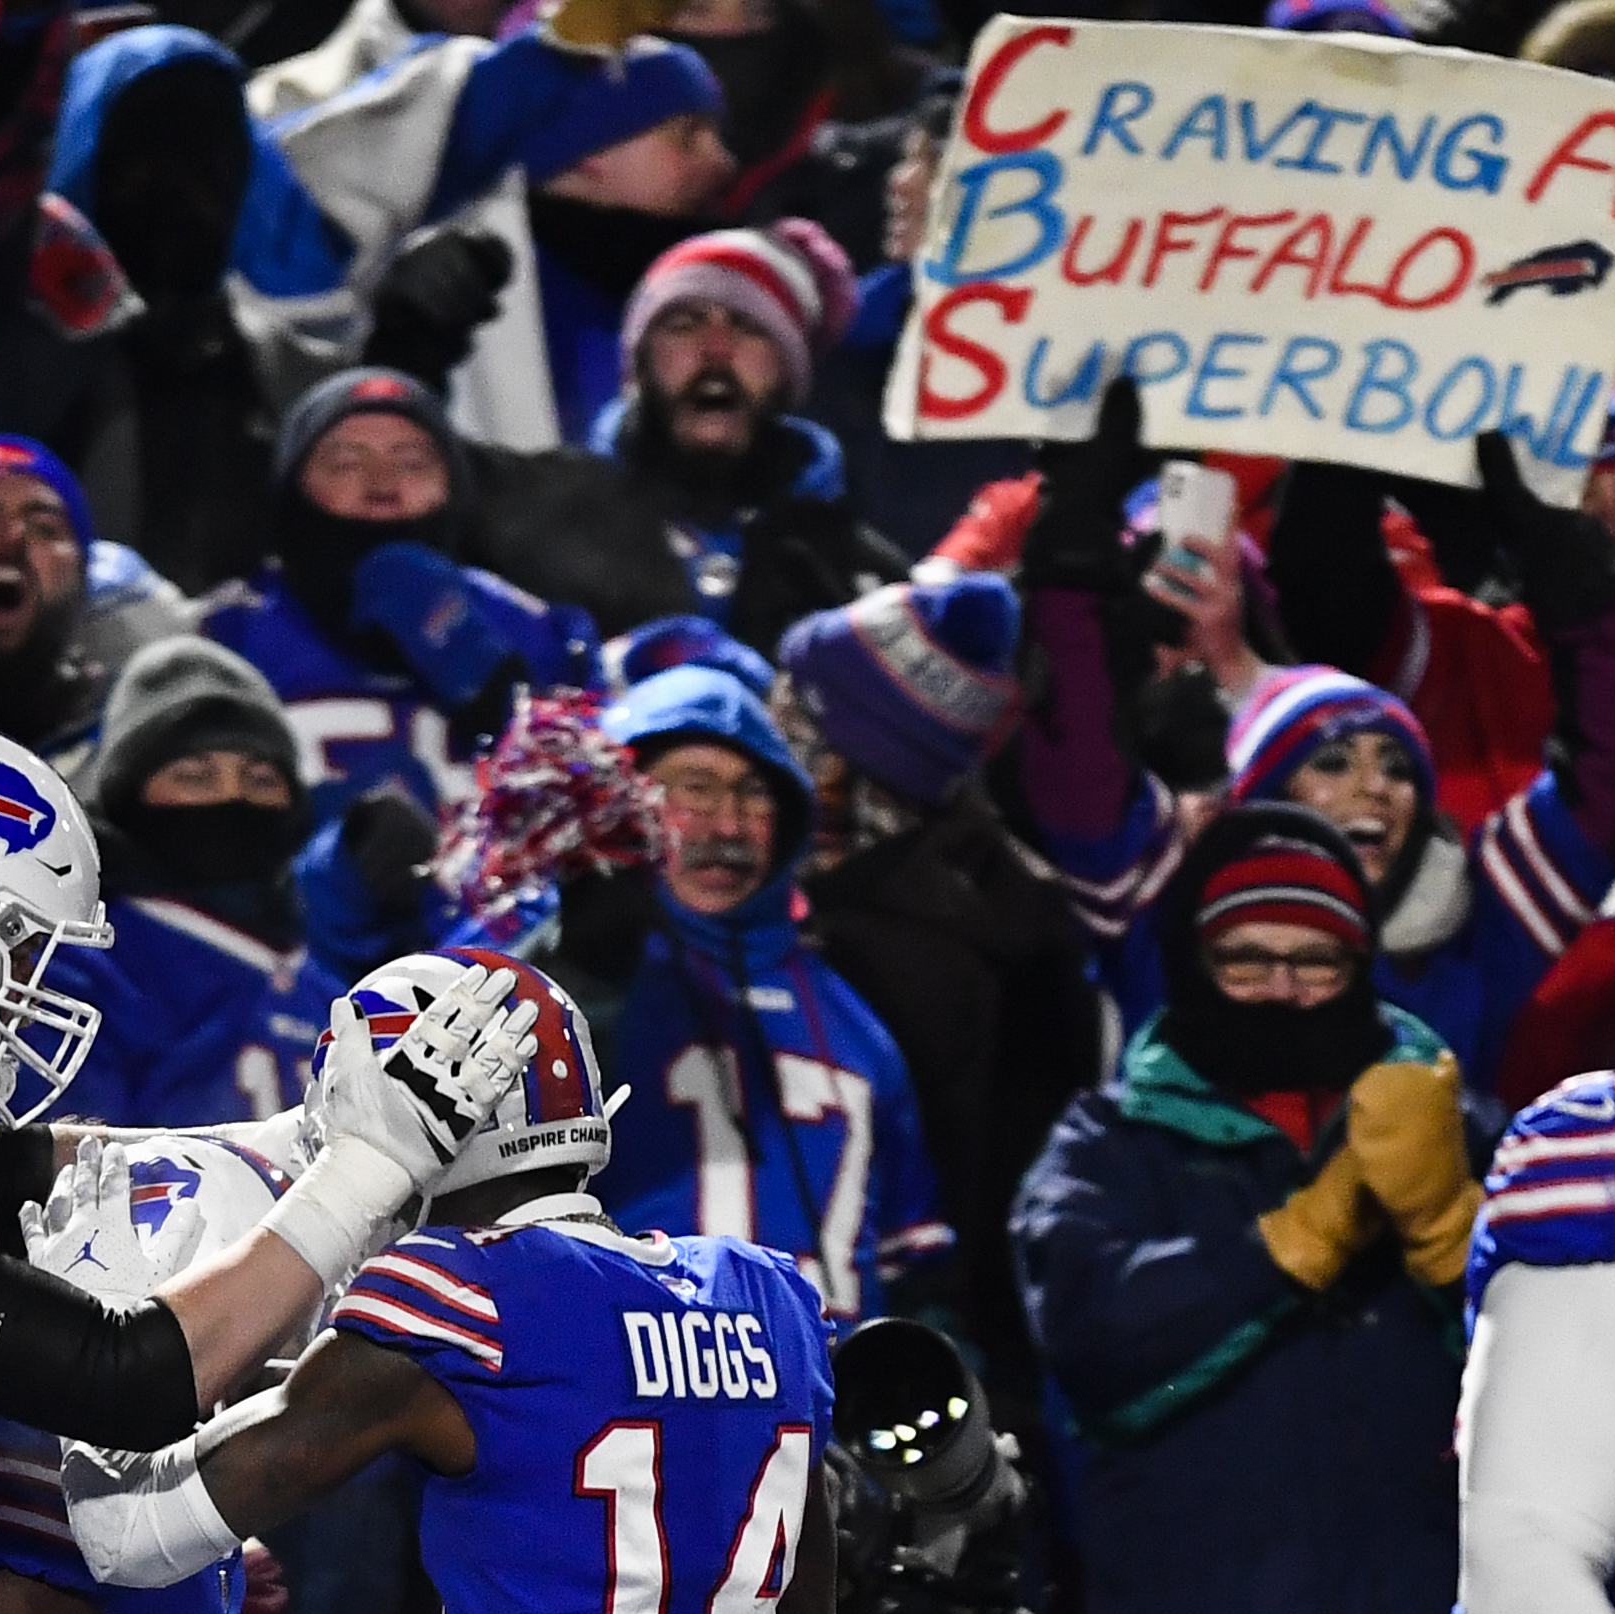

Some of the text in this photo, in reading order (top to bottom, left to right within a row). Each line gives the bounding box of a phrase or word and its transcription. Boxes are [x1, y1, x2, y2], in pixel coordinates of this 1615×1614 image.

[963, 26, 1509, 196] CRAVING
[923, 149, 1477, 312] BUFFALO
[916, 280, 1611, 469] SUPERBOWL
[498, 1130, 567, 1159] INSPIRE
[666, 1043, 873, 1319] 17
[621, 1309, 781, 1401] DIGGS
